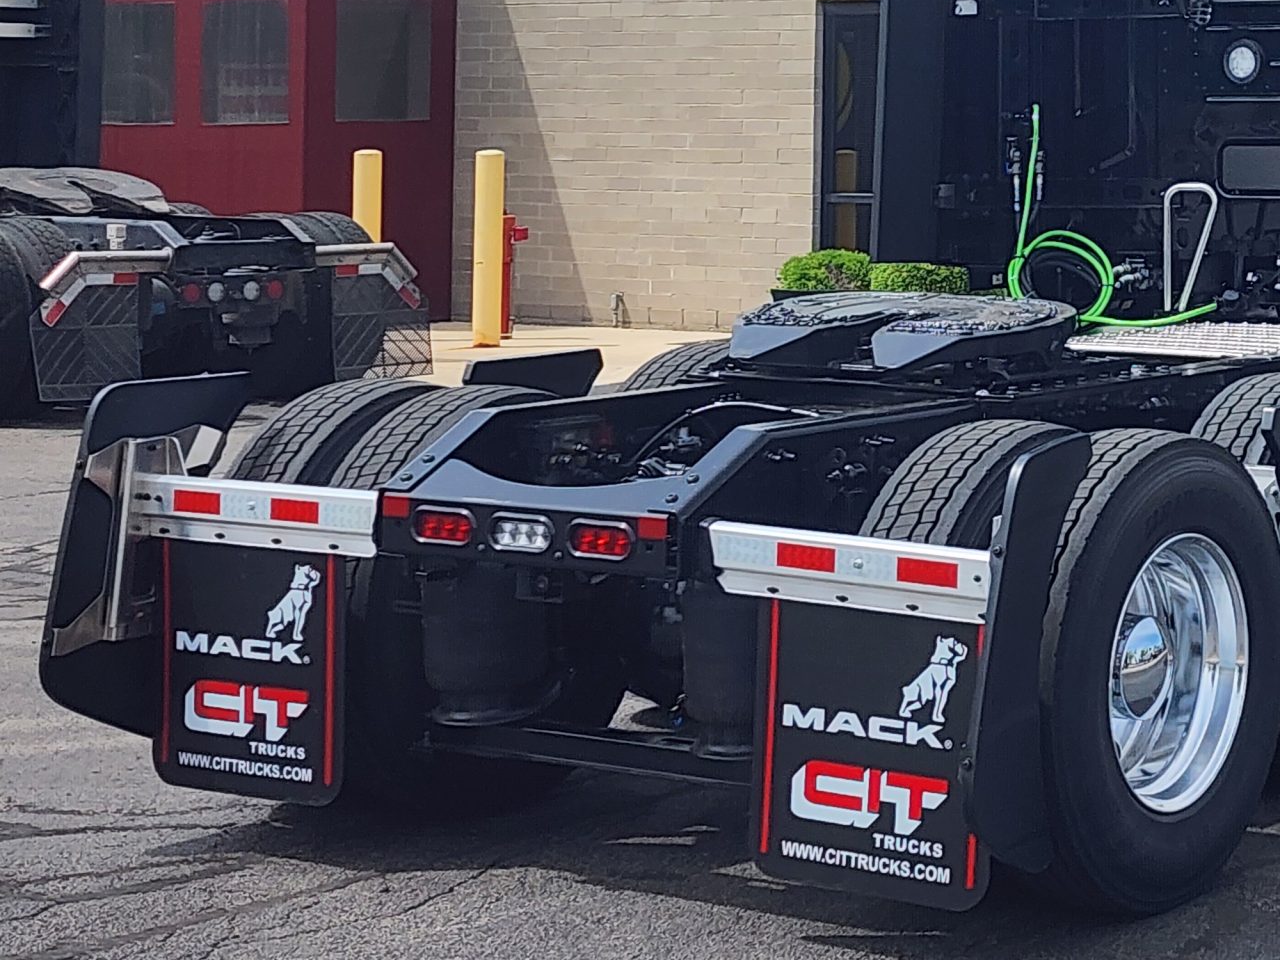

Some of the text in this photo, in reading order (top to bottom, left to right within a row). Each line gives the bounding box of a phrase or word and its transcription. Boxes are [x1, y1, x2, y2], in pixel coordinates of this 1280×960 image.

[176, 631, 302, 664] MACK
[186, 680, 309, 741] CIT
[782, 704, 944, 749] MACK
[178, 751, 313, 783] WWW.CITTRUCKS.COM
[249, 742, 306, 760] TRUCKS
[791, 760, 949, 835] CIT
[781, 840, 951, 884] WWW.CITTRUCKS.COM
[873, 833, 943, 859] TRUCKS
